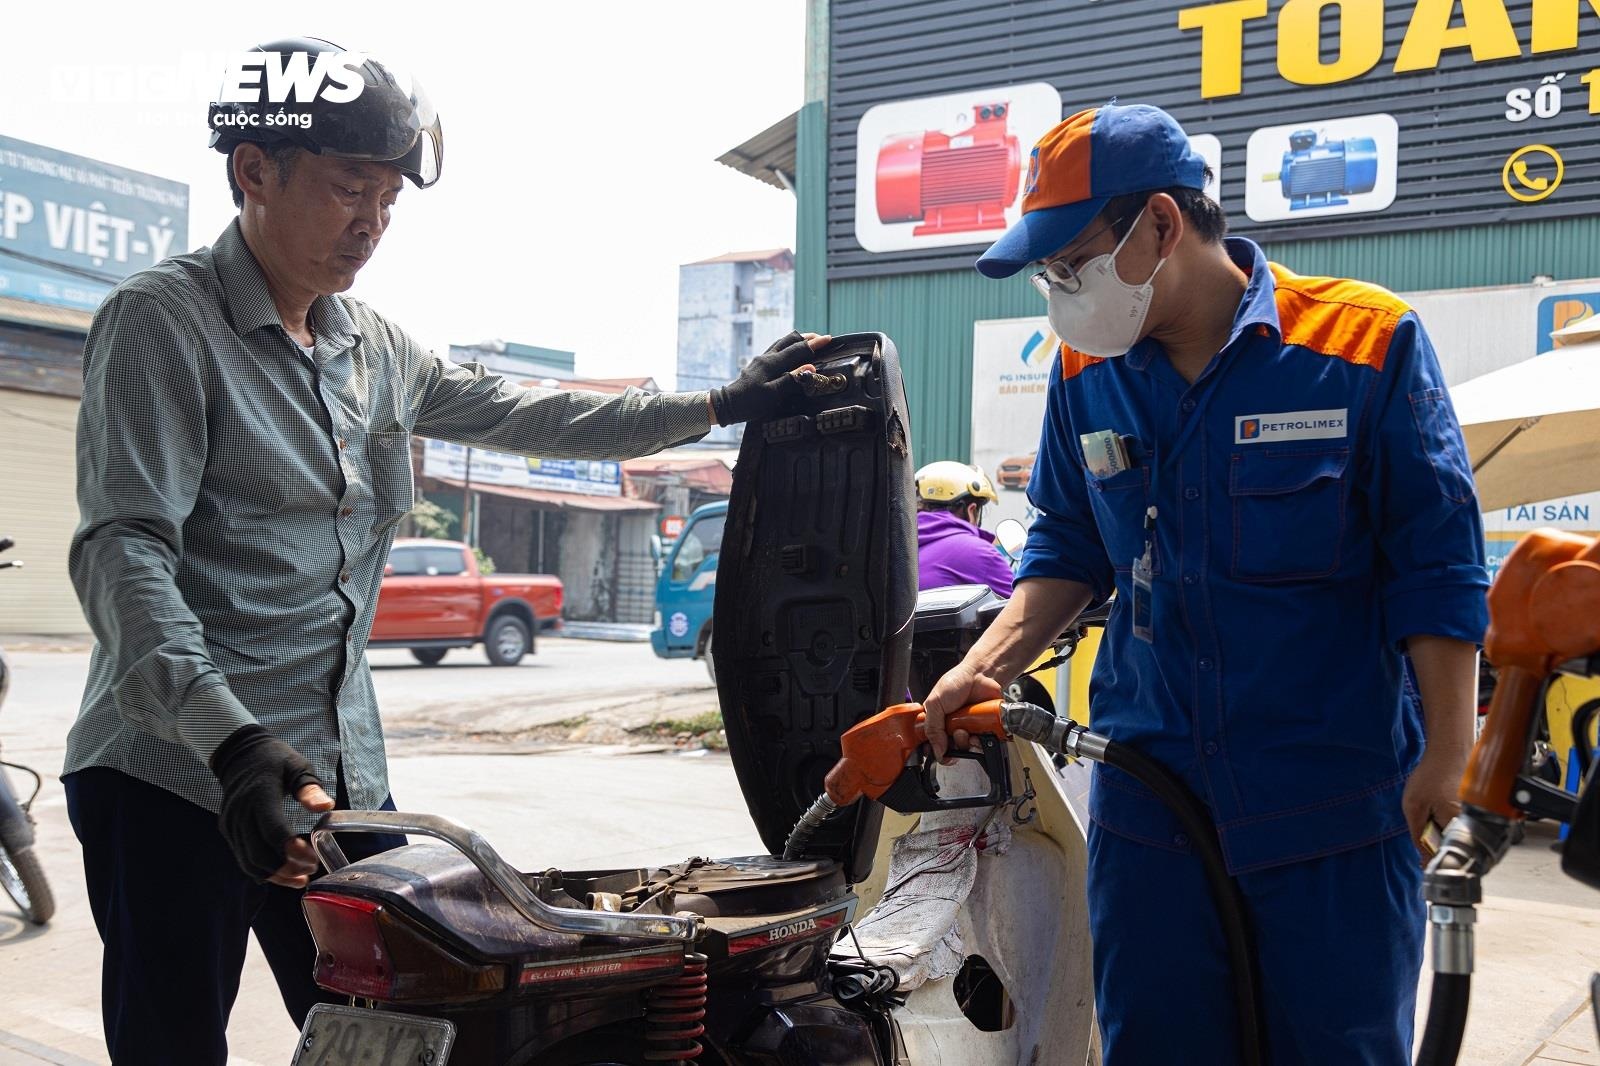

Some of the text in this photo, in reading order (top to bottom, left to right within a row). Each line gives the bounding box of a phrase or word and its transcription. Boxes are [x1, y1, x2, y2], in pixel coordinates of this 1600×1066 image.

[1505, 72, 1566, 122] SỐ
[43, 201, 175, 267] VIỆT-Ý
[1262, 419, 1344, 431] PETROLIMEX
[1543, 500, 1589, 521] SẢN
[769, 918, 817, 941] HONDA
